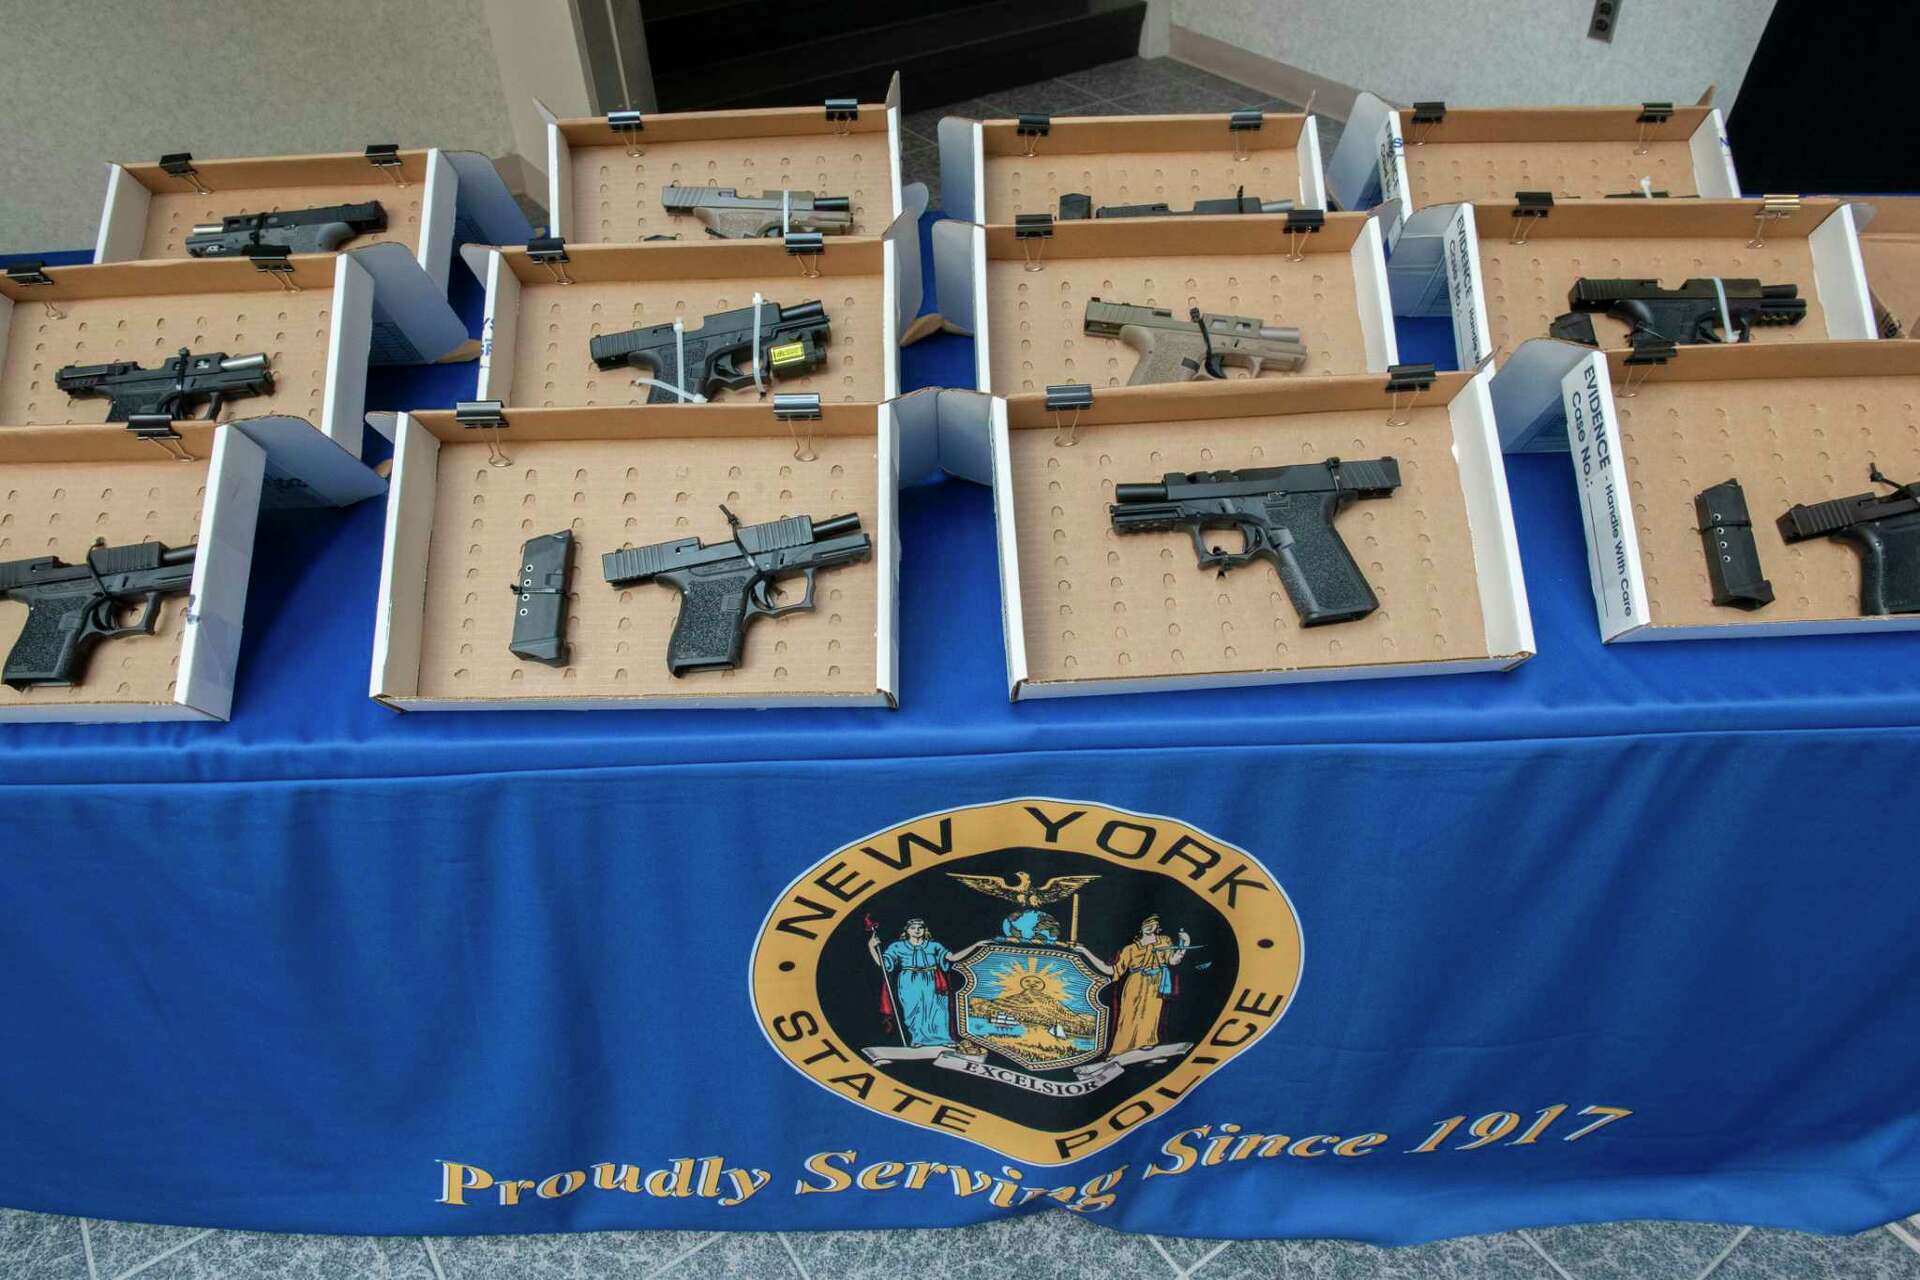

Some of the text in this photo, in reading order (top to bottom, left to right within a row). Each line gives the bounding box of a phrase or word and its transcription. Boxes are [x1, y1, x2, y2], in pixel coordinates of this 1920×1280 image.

[1449, 239, 1458, 282] Case
[1456, 215, 1473, 298] EVIDENCE
[1571, 391, 1586, 442] Case
[1584, 365, 1611, 470] EVIDENCE
[1605, 483, 1619, 539] Handle
[1615, 540, 1626, 576] With
[1620, 578, 1632, 617] Care
[775, 806, 1270, 941] NEW YORK
[772, 987, 1284, 1160] STATE POLICE
[963, 1060, 1101, 1098] EXCELSIOR
[434, 1155, 772, 1207] Proudly
[1141, 1122, 1389, 1181] Since
[1401, 1102, 1634, 1154] 1917
